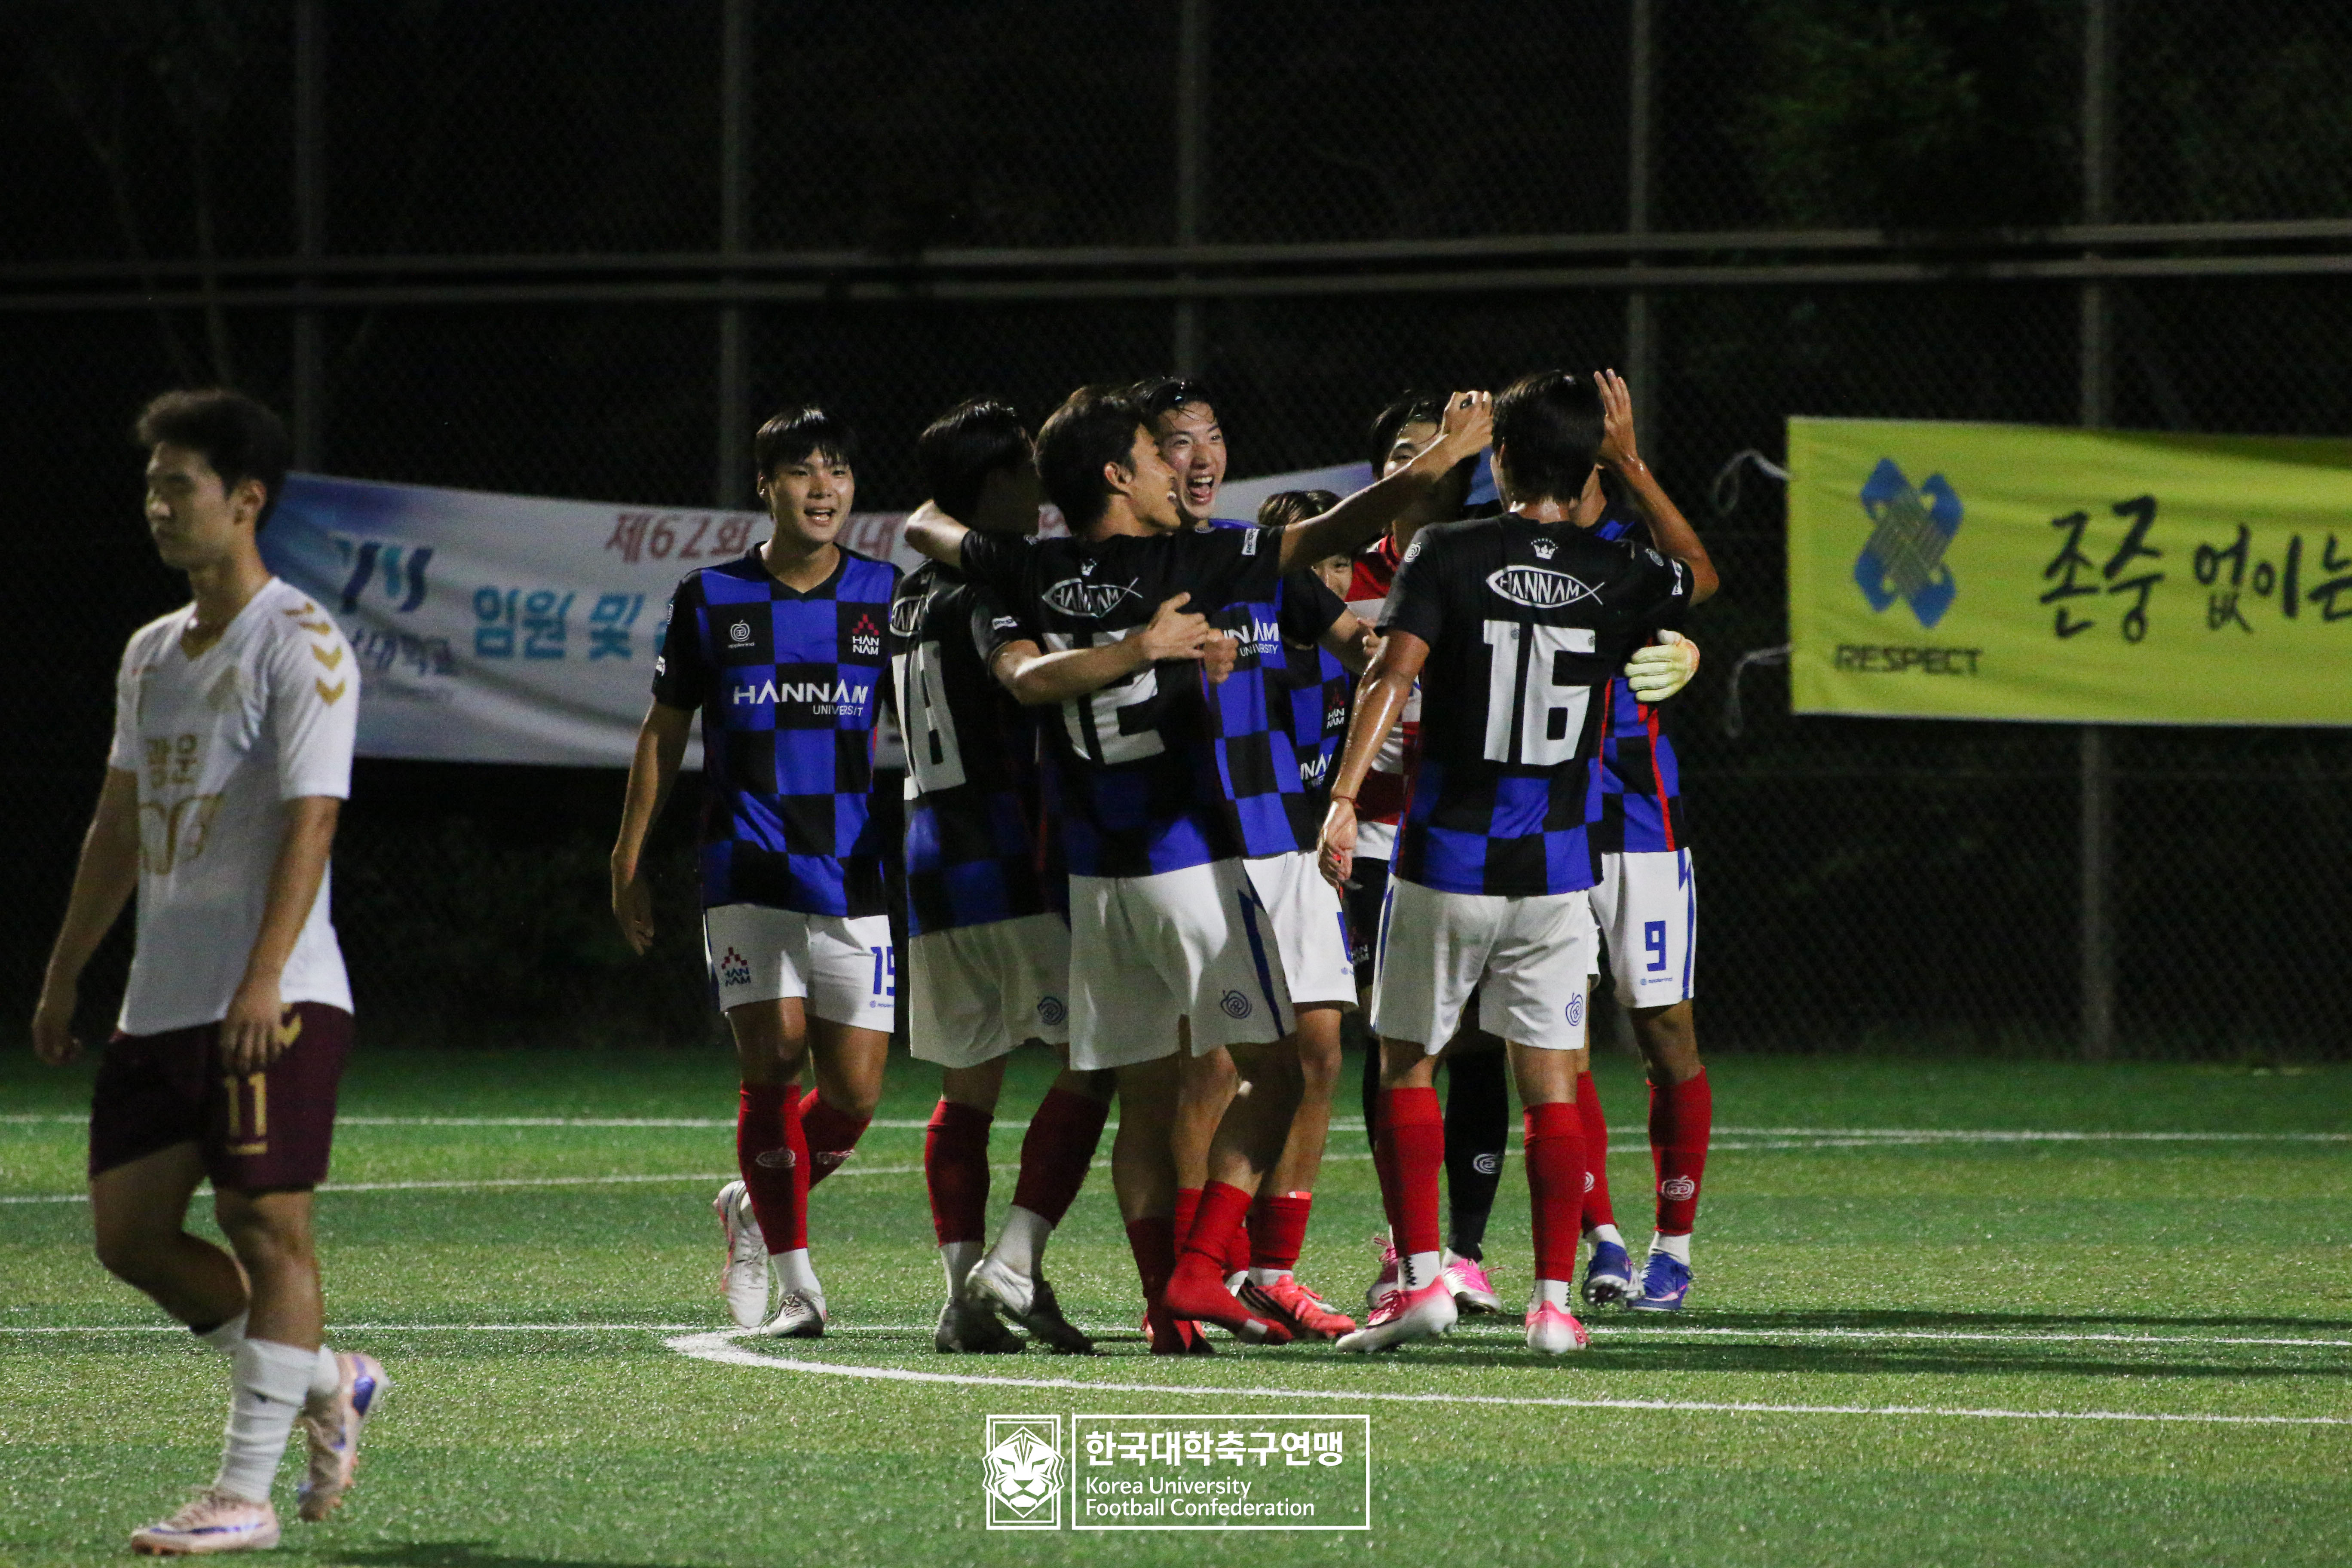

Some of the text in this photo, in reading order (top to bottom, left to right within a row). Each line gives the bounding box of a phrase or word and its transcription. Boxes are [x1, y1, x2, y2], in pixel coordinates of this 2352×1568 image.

[2040, 495, 2352, 643] 존중 없이는
[1500, 571, 1580, 603] HANNAM
[473, 585, 576, 661] 임원
[588, 591, 646, 662] 및
[852, 634, 880, 646] HAN
[852, 644, 879, 655] NAM
[1834, 643, 1983, 676] RESPECT
[733, 678, 869, 705] HANNAM
[1483, 619, 1596, 766] 16
[813, 704, 864, 717] UNIVERSIT
[1645, 920, 1666, 972] 9
[222, 1071, 268, 1137] 11
